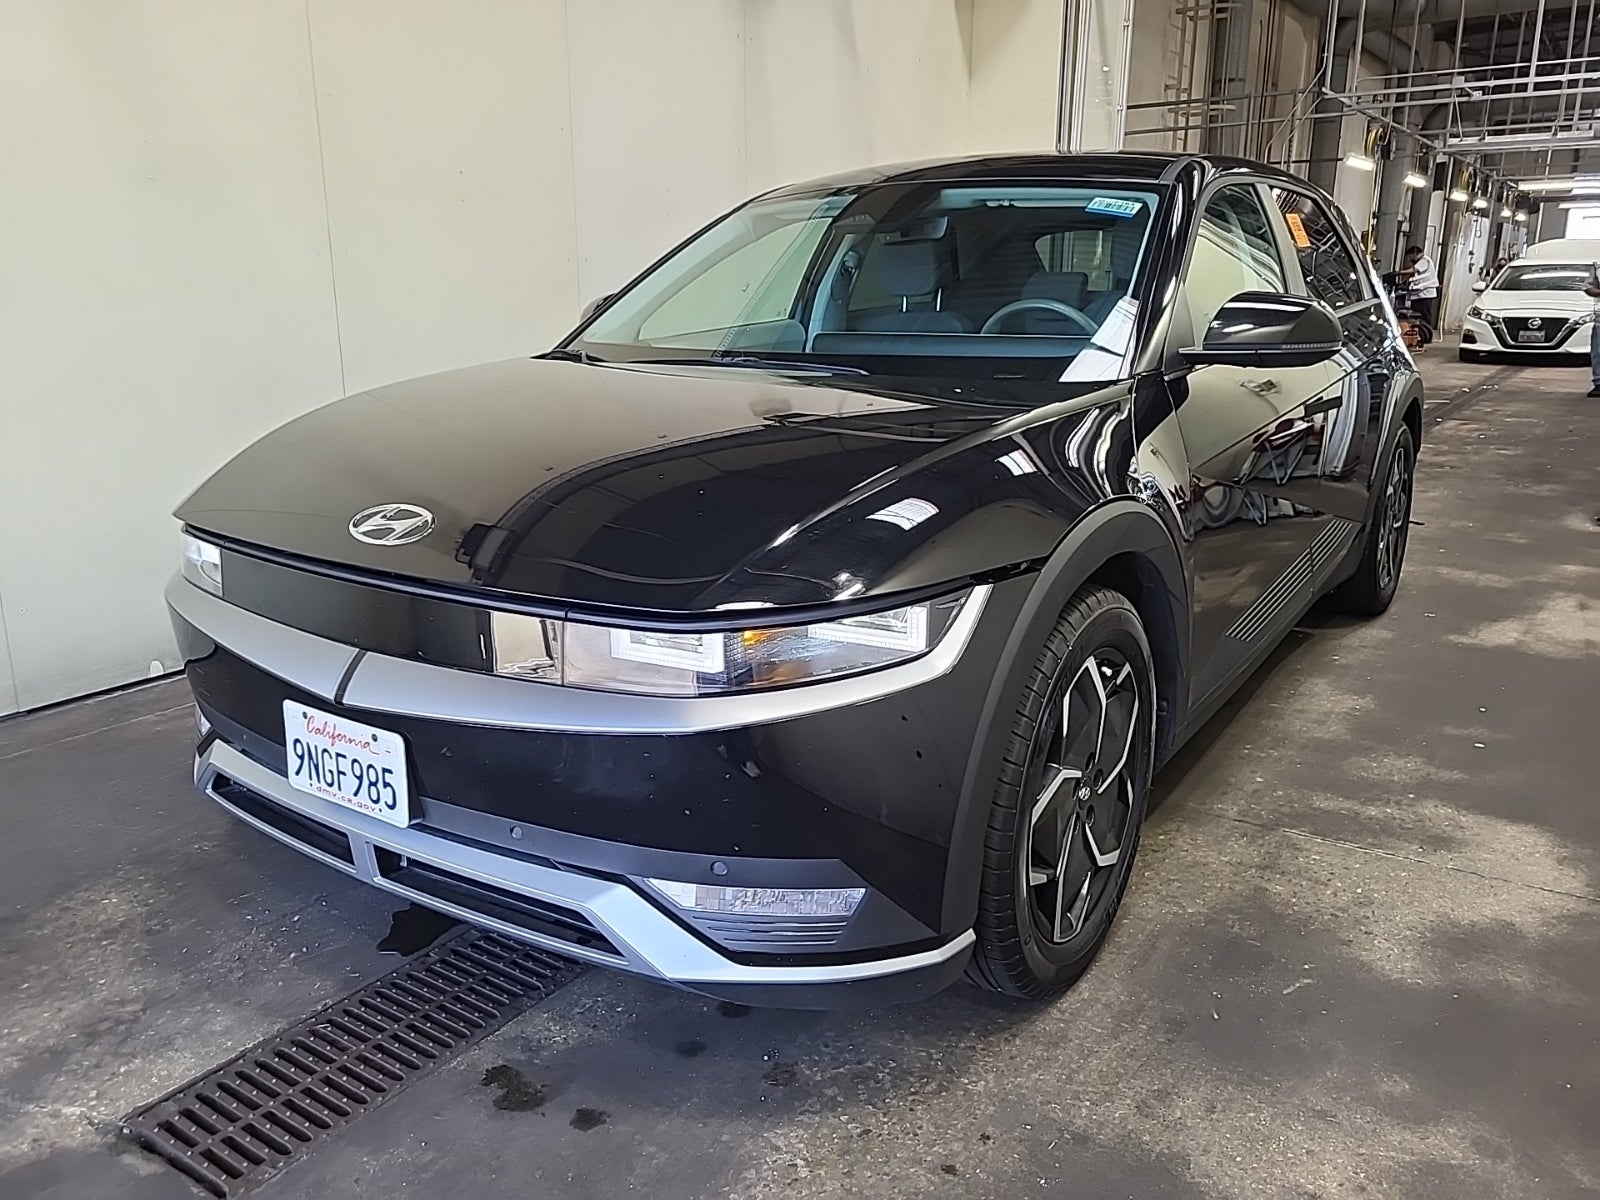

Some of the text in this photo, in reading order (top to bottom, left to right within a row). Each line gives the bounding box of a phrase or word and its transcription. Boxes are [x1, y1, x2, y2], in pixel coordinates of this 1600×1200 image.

[306, 714, 380, 755] California
[293, 737, 397, 810] 9NGF985
[315, 785, 376, 812] dmv.ca.gov
